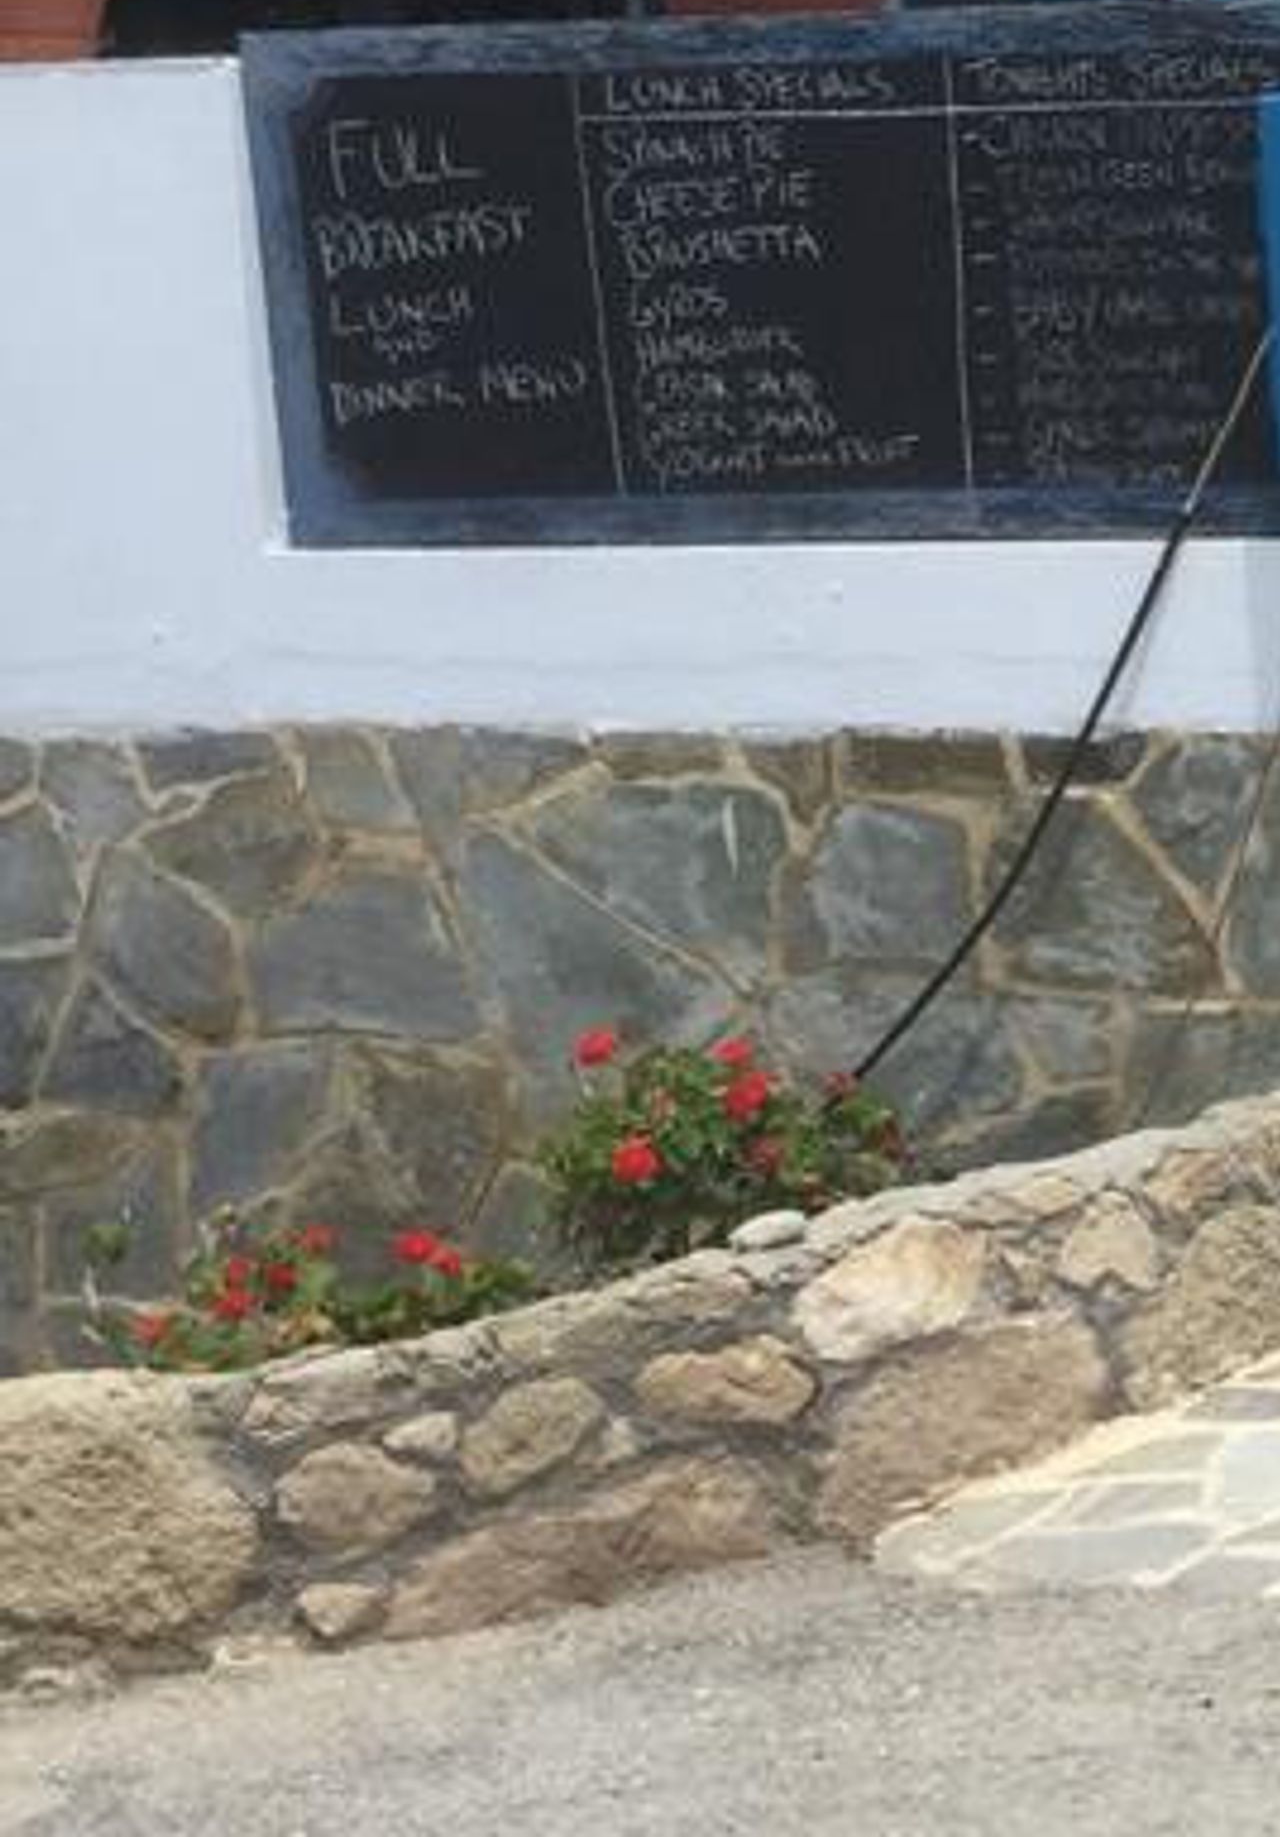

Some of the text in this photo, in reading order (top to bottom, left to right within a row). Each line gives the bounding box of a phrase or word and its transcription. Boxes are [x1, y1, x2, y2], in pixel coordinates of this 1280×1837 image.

[606, 66, 895, 111] LUNCH SPECIALS
[328, 119, 486, 200] FULL
[604, 166, 814, 227] CHEESE PIE
[314, 204, 532, 278] BREAKFAST
[328, 286, 473, 336] LUNCH
[631, 282, 730, 328] GYROS
[480, 360, 588, 404] MENU
